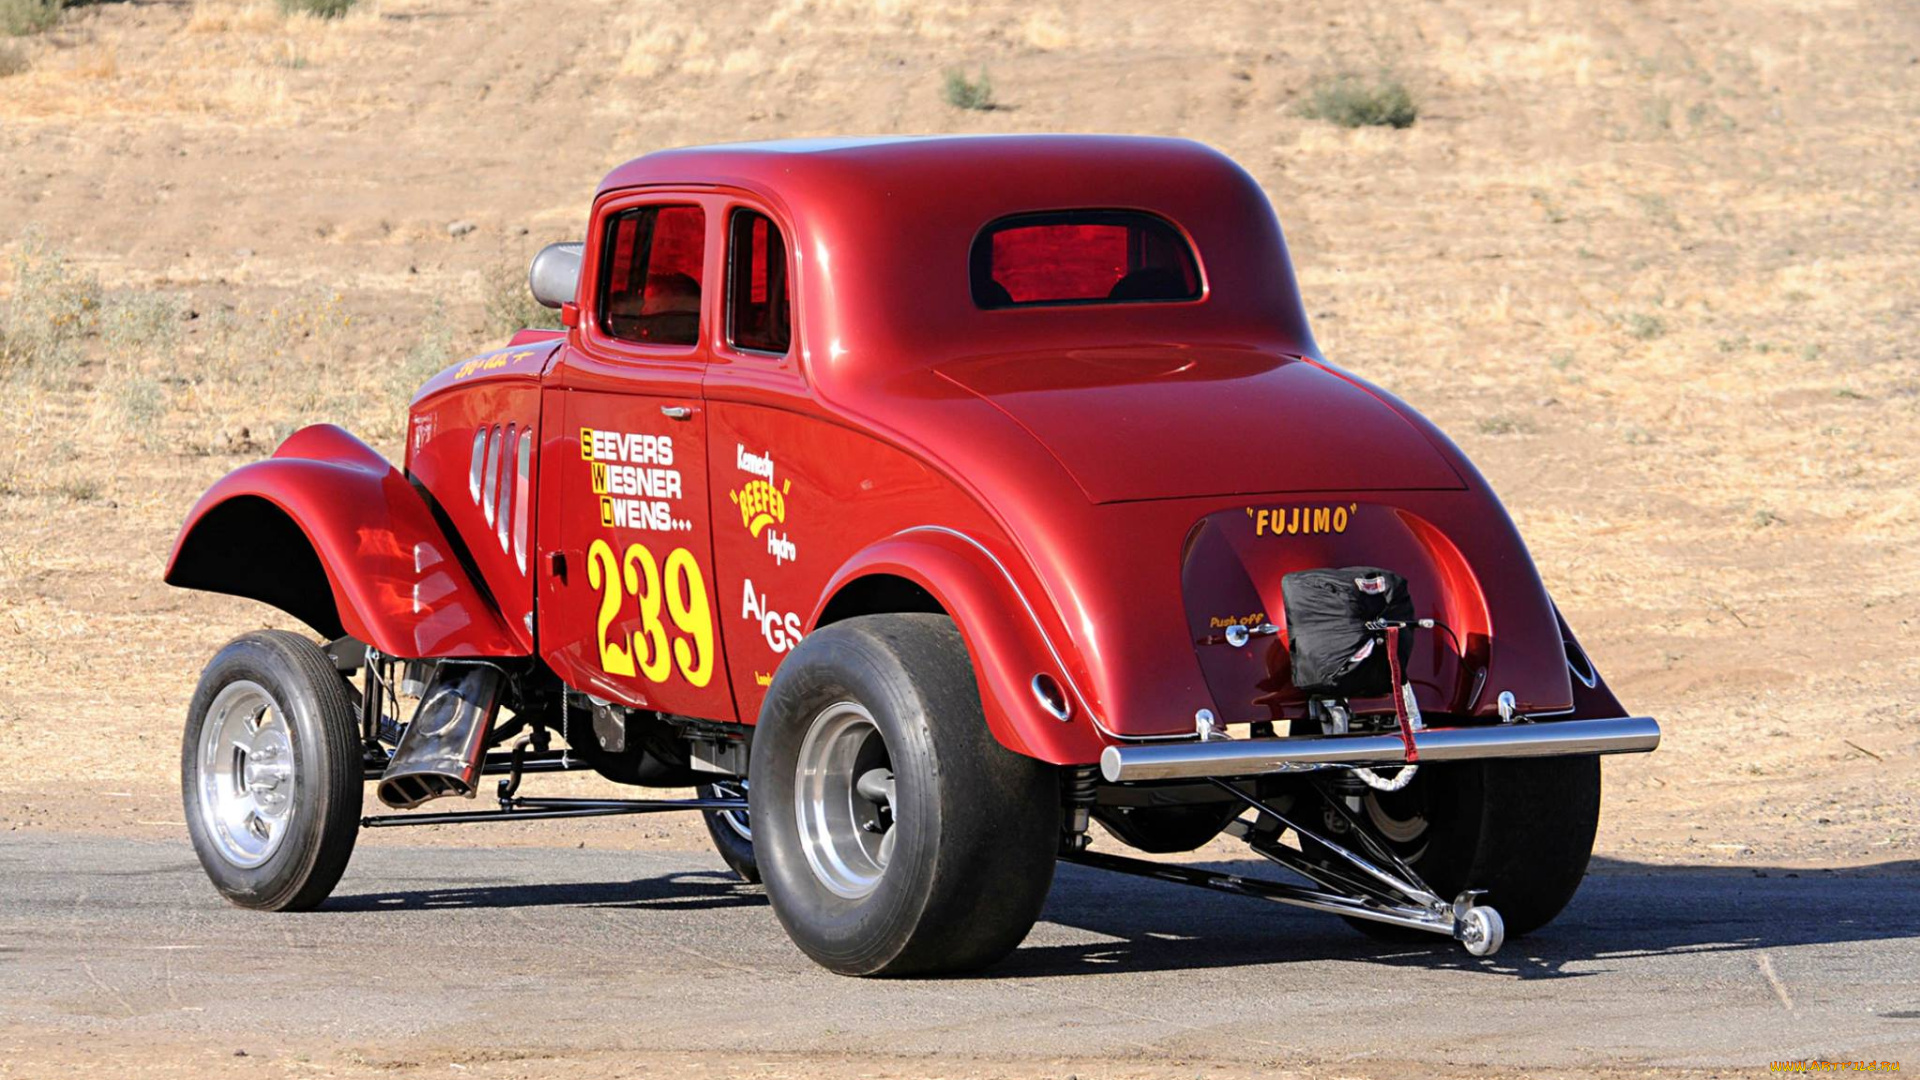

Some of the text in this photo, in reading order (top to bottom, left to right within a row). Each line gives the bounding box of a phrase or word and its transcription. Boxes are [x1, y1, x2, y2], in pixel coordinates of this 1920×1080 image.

[581, 428, 673, 466] SEEVERS
[591, 462, 682, 499] WIESNER
[767, 528, 796, 566] Hydro
[587, 538, 714, 688] 239
[1210, 615, 1236, 628] Push
